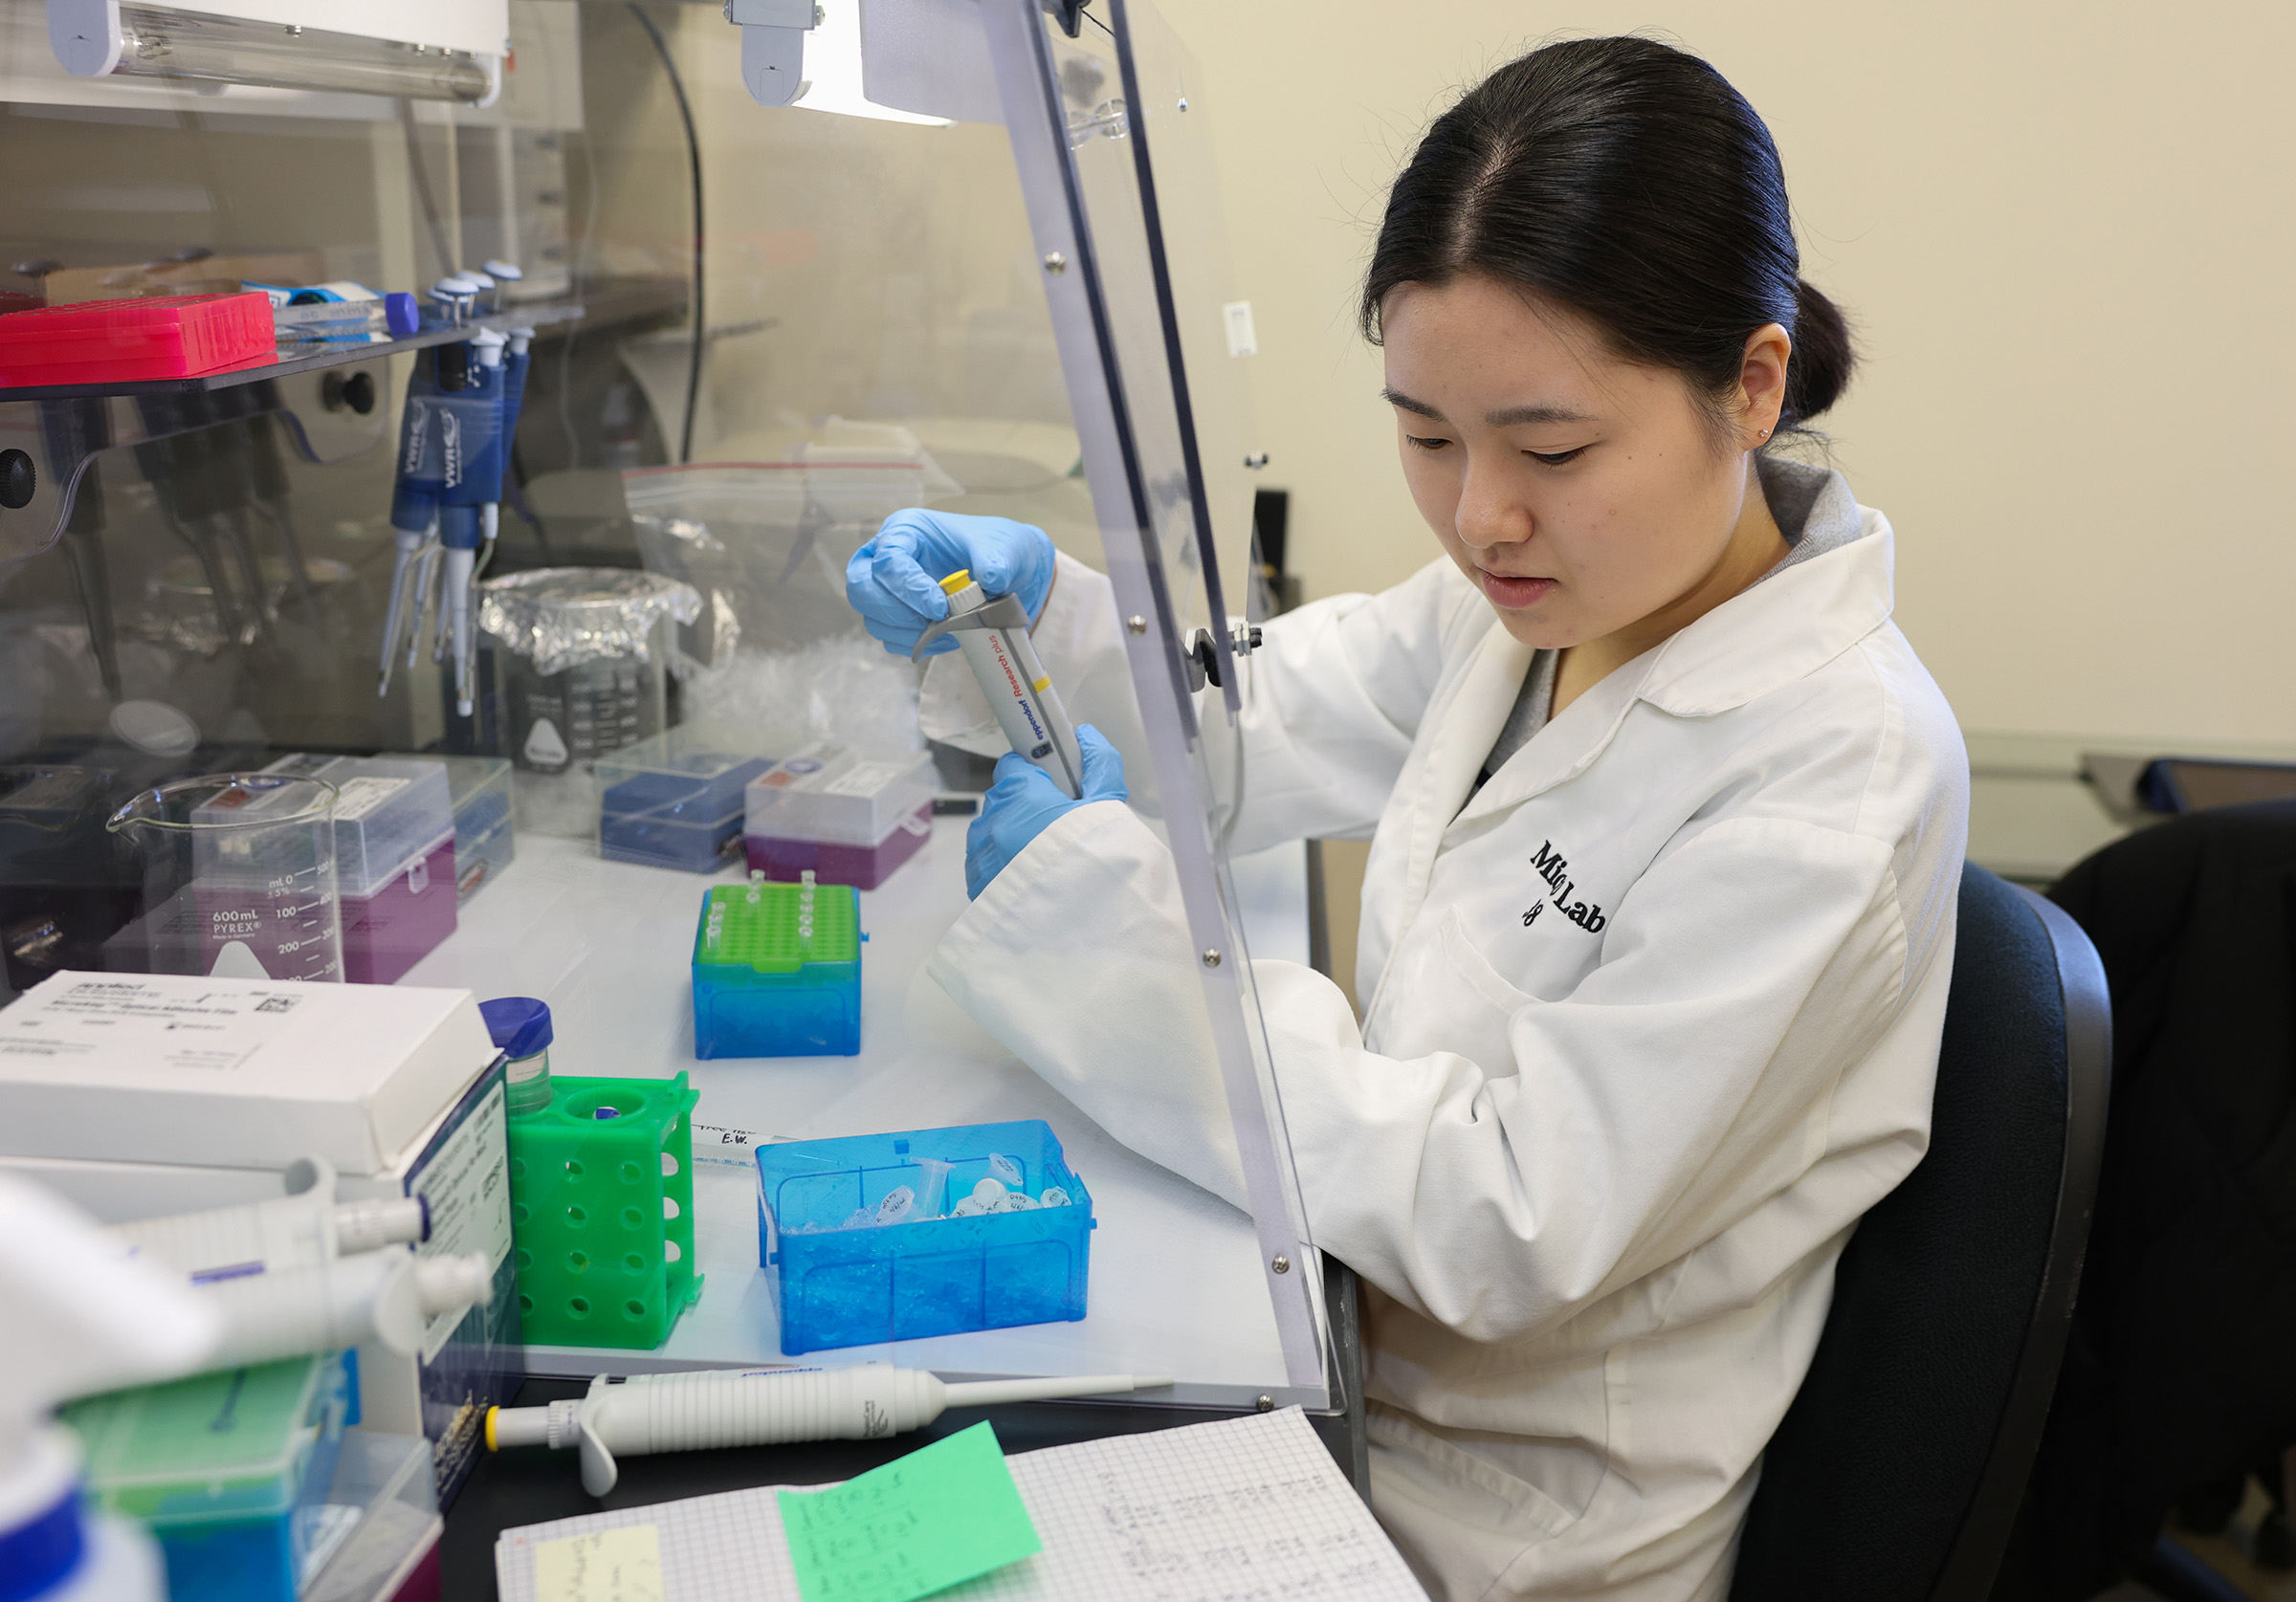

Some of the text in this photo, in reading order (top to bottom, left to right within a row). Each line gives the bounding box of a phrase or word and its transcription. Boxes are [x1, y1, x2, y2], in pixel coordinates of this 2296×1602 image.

[445, 449, 456, 489] VWR
[988, 635, 1004, 654] plus
[998, 654, 1023, 697] Research
[1018, 699, 1044, 740] eppendorf
[276, 906, 297, 919] 100
[1553, 881, 1606, 933] Lab
[278, 940, 299, 955] 200
